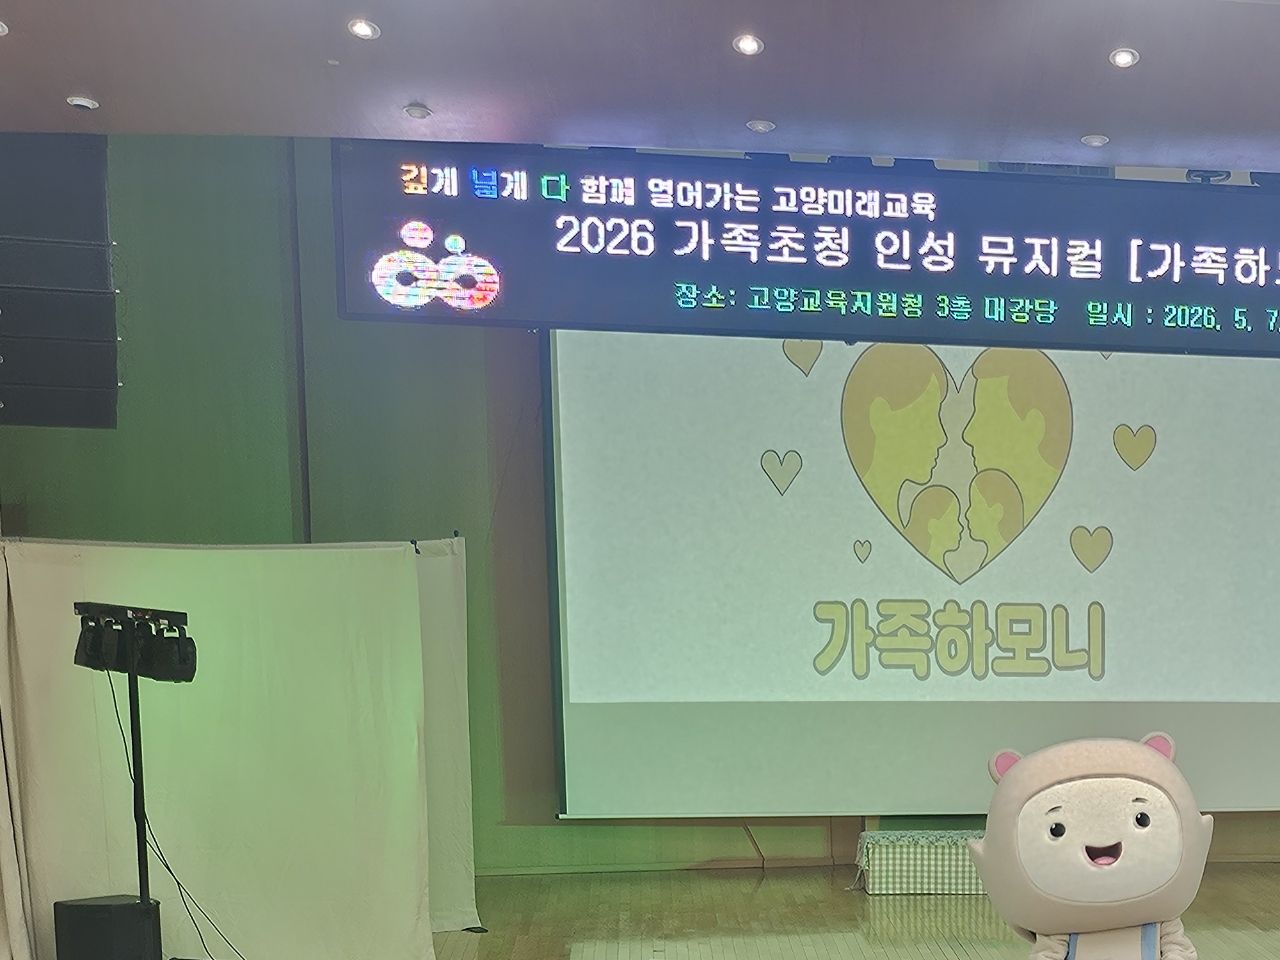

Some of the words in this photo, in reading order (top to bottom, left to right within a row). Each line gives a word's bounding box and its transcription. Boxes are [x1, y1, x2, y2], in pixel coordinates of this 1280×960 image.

[400, 163, 459, 198] 깊게
[471, 167, 529, 202] 넓게
[541, 173, 572, 203] 다
[580, 174, 635, 206] 함께
[647, 177, 761, 213] 열어가는
[771, 186, 937, 222] 고양미래교육
[555, 215, 656, 257] 2026
[673, 219, 850, 268] 가족초청
[875, 229, 956, 272] 인성
[978, 235, 1103, 280] 뮤지컬
[673, 281, 736, 309] 장소:
[747, 285, 924, 319] 고양교육지원청
[935, 294, 973, 321] 3층
[983, 296, 1059, 325] 대강당
[1086, 301, 1133, 327] 일시
[1163, 304, 1222, 332] 2026.
[1233, 306, 1253, 333] 5.
[813, 598, 1106, 681] 가족하모니
